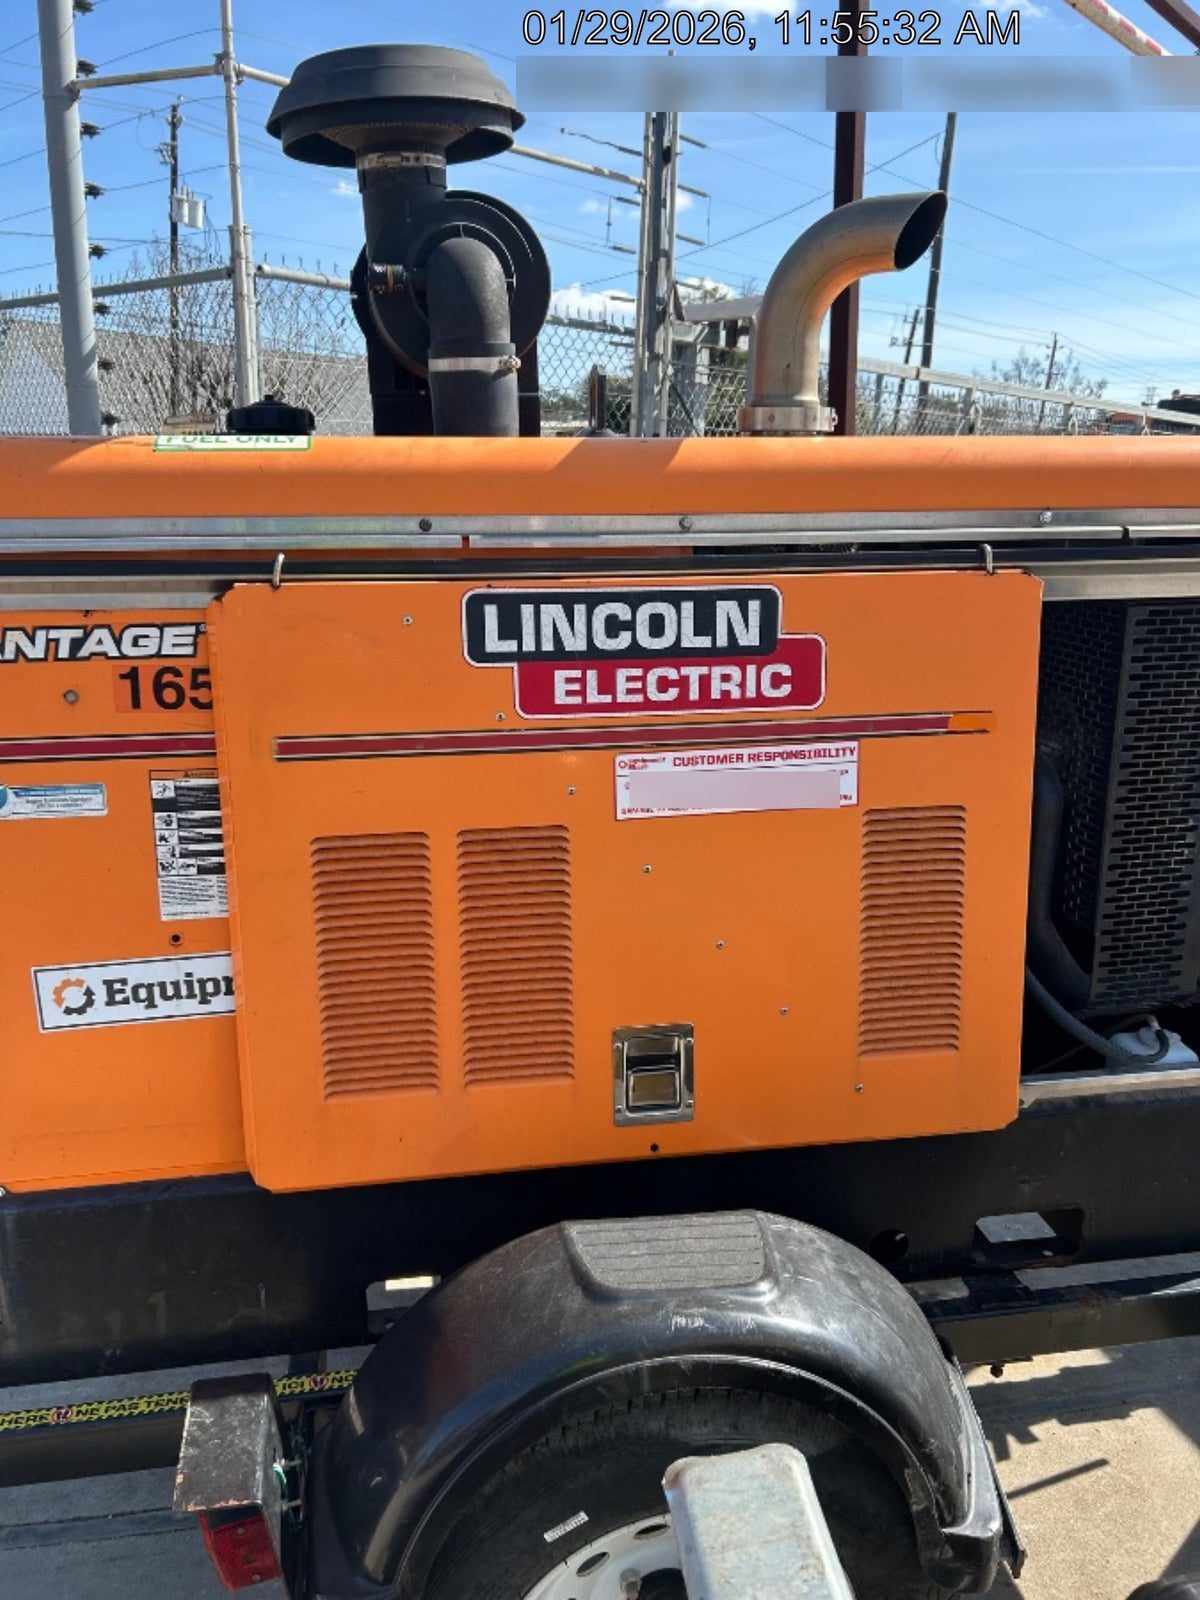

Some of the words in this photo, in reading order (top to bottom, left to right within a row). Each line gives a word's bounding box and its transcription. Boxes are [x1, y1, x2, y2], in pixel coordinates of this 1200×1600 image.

[0, 624, 200, 661] NTAGE
[483, 600, 761, 654] LINCOLN
[554, 664, 793, 705] ELECTRIC
[673, 751, 744, 767] CUSTOMER
[747, 746, 856, 763] RESPONSIBILITY
